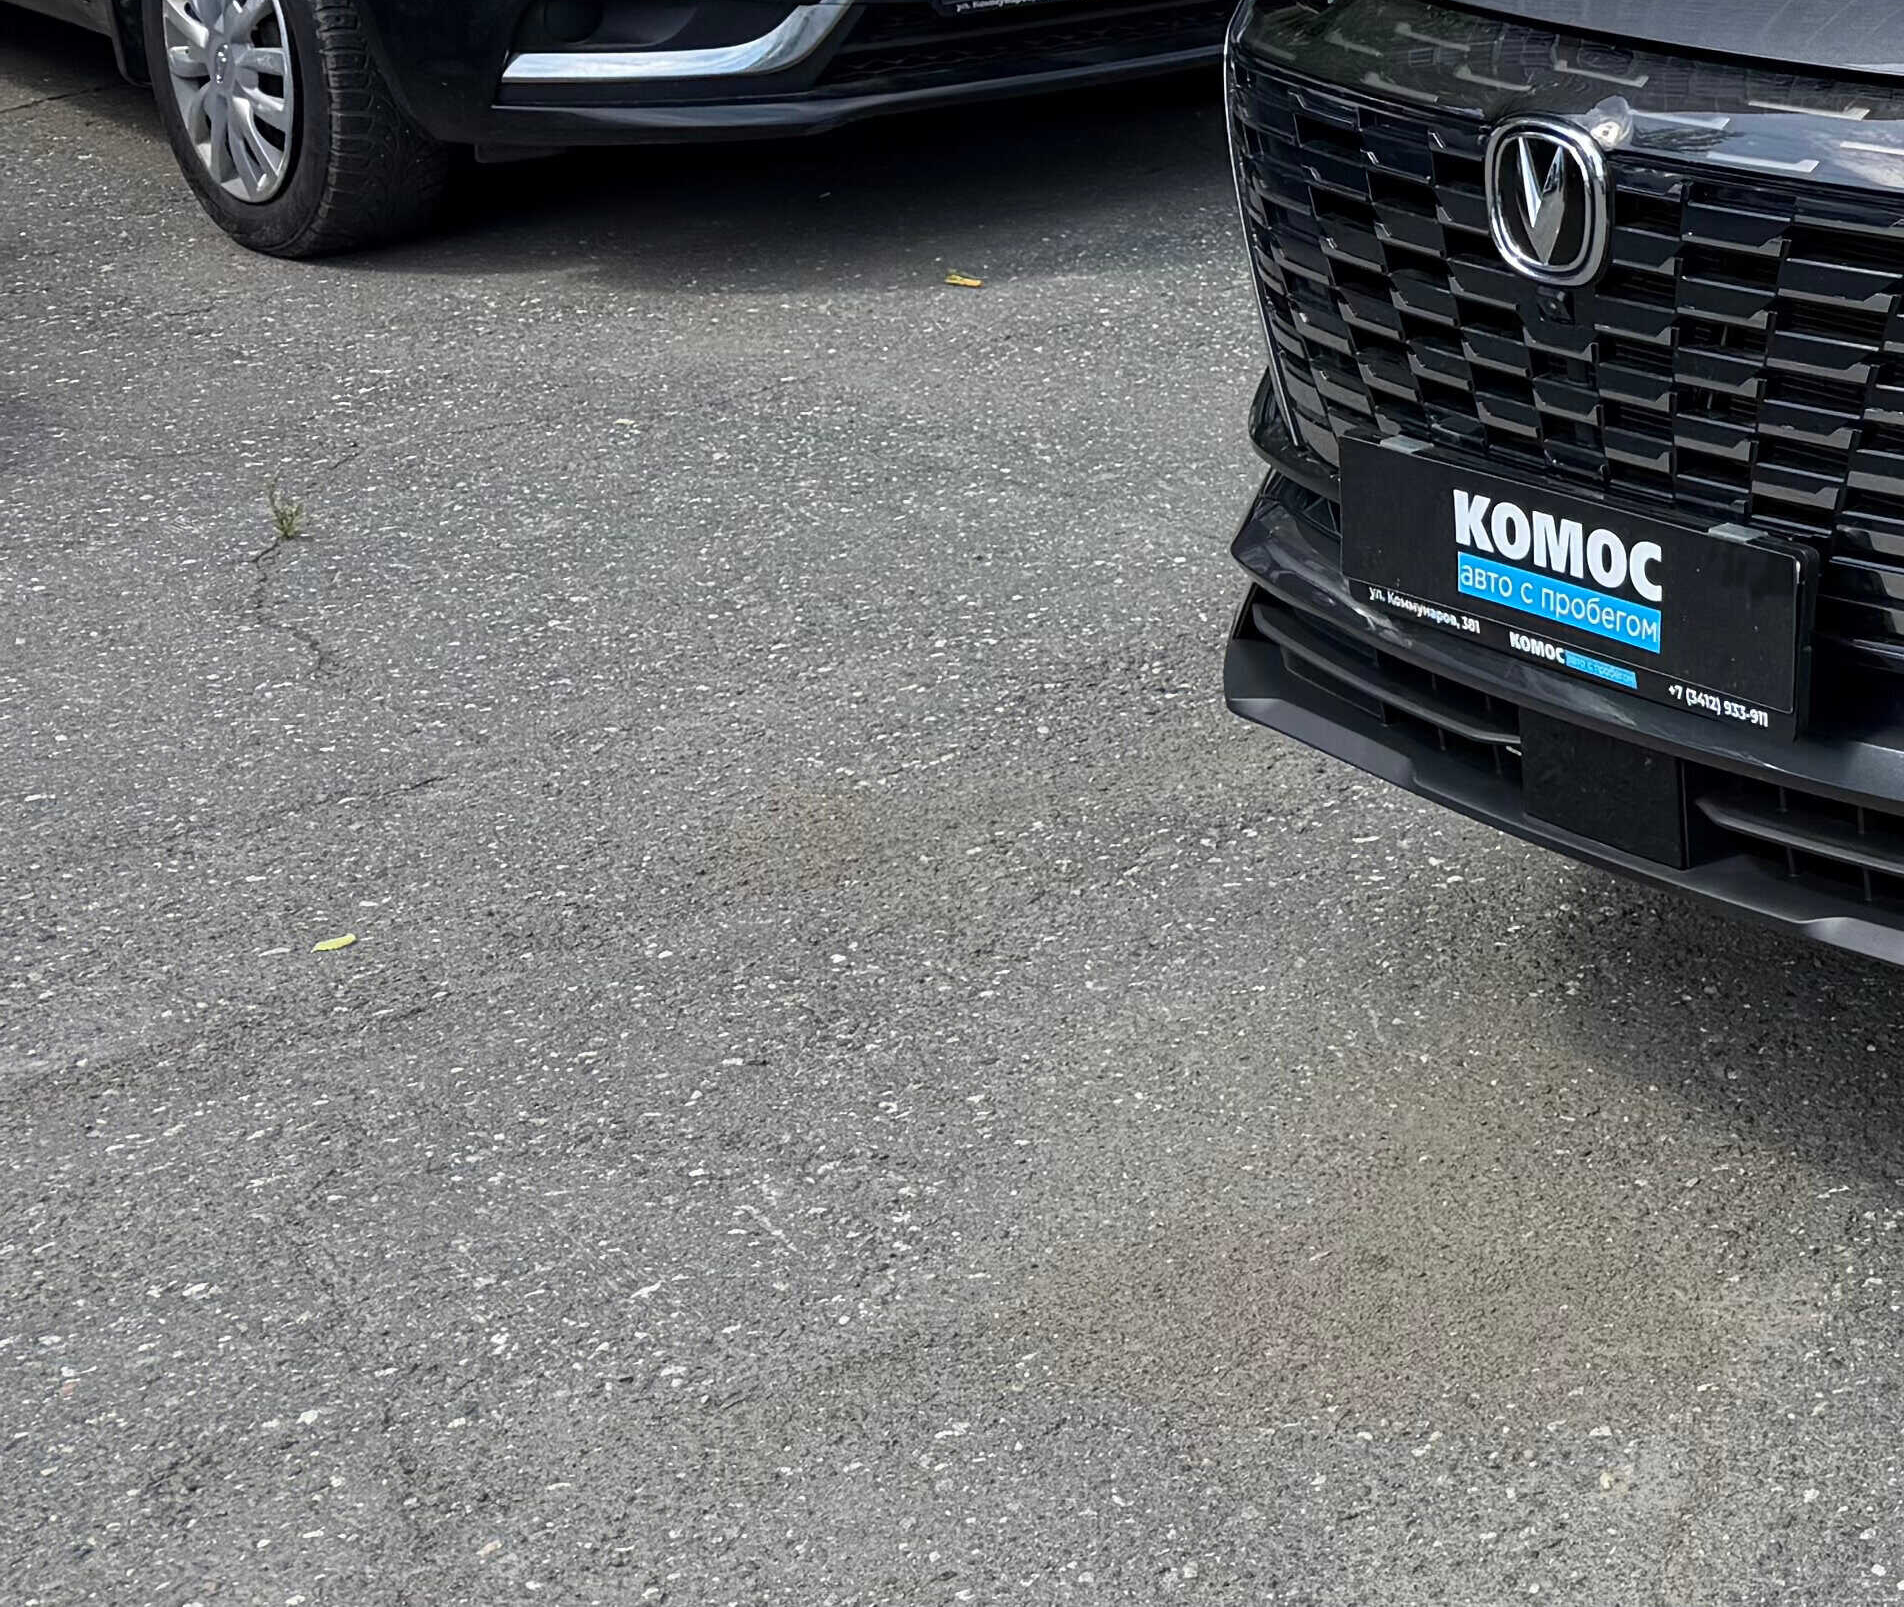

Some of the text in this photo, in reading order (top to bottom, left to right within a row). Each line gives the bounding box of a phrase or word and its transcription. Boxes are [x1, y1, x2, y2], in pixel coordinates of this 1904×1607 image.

[1453, 489, 1663, 602] КОМОС
[1368, 586, 1481, 634] ул. Коммунаров, 381
[1460, 564, 1659, 643] авто с пробегом
[1508, 630, 1566, 664] КОМОС
[1668, 684, 1769, 728] +7 (3412) 933-911
